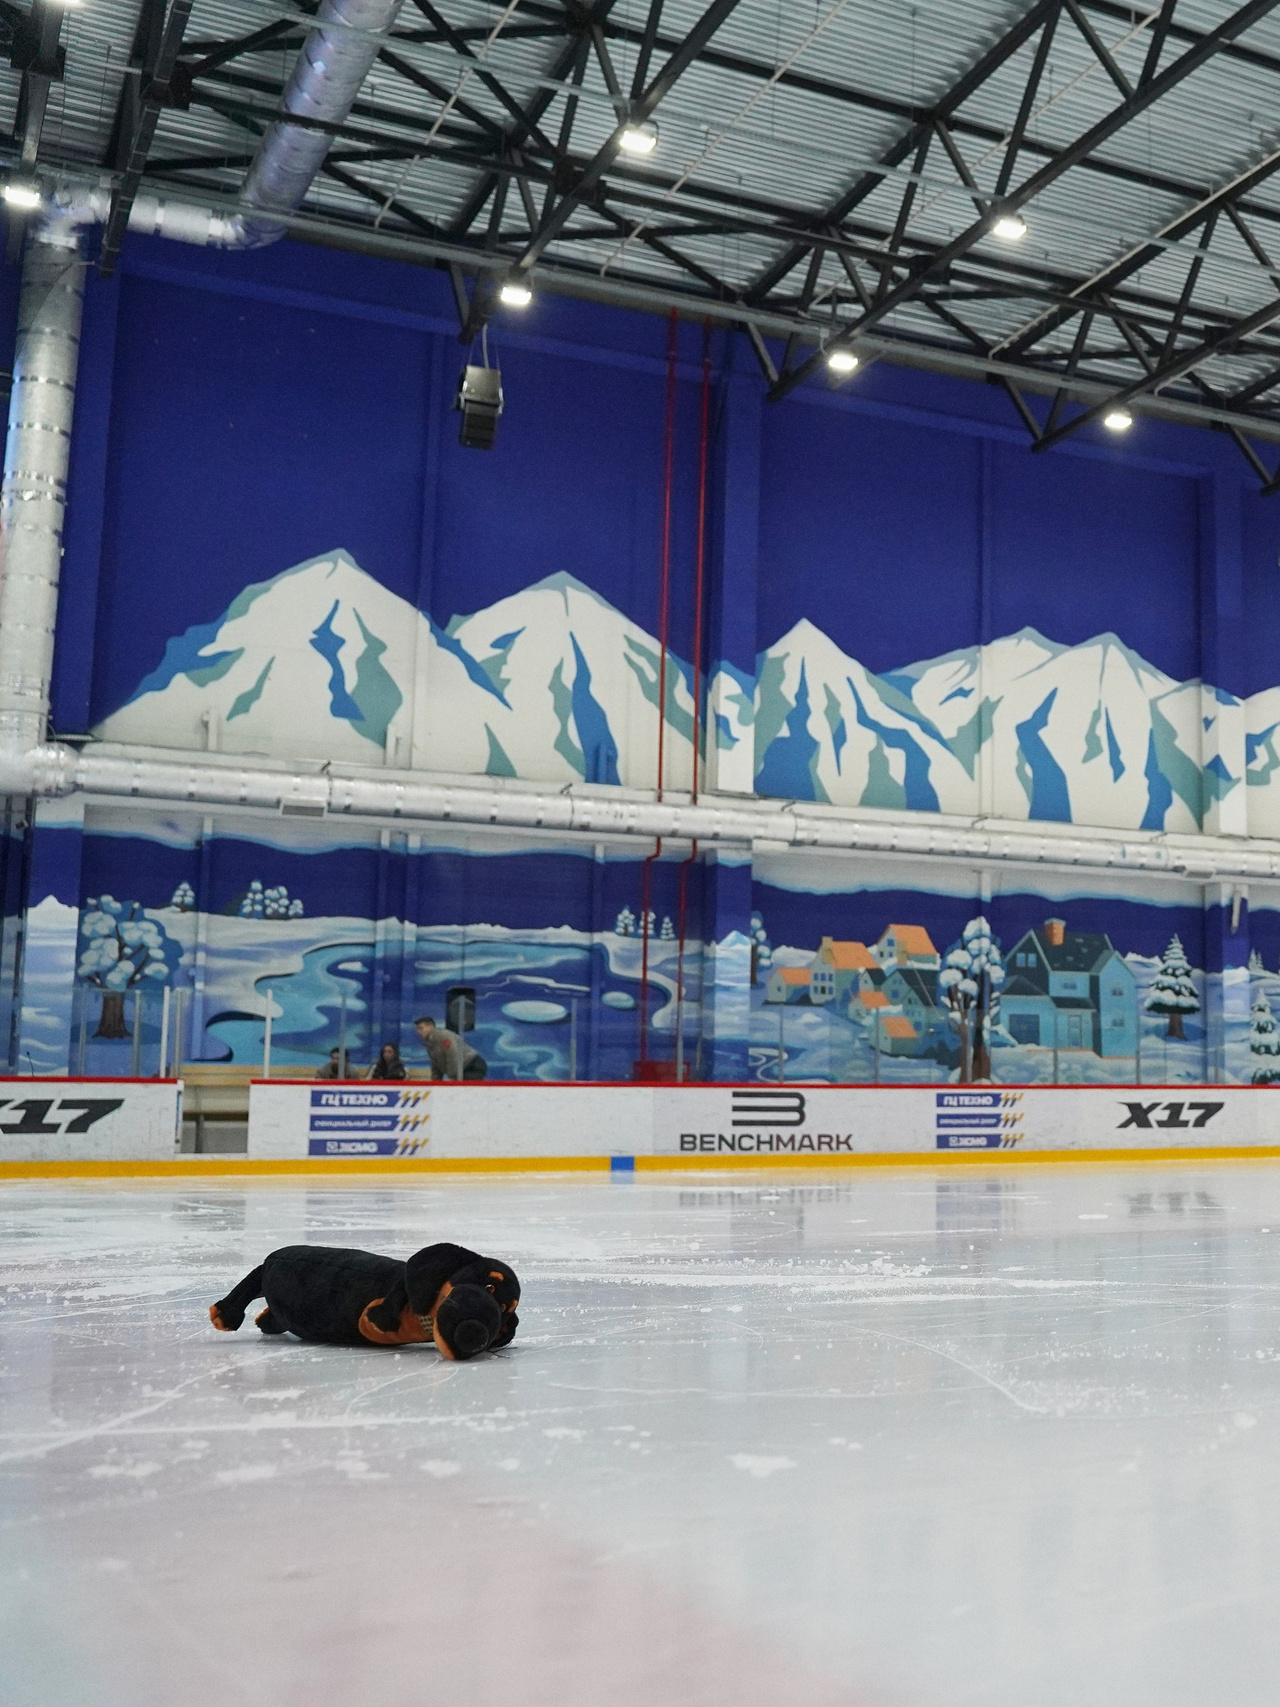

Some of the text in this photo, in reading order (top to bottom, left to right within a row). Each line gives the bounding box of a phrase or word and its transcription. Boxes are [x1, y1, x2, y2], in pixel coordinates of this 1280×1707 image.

[342, 1094, 388, 1105] ТЕХНО
[0, 1099, 125, 1134] 17
[1116, 1101, 1225, 1128] X17
[680, 1133, 854, 1151] BENCHMARK
